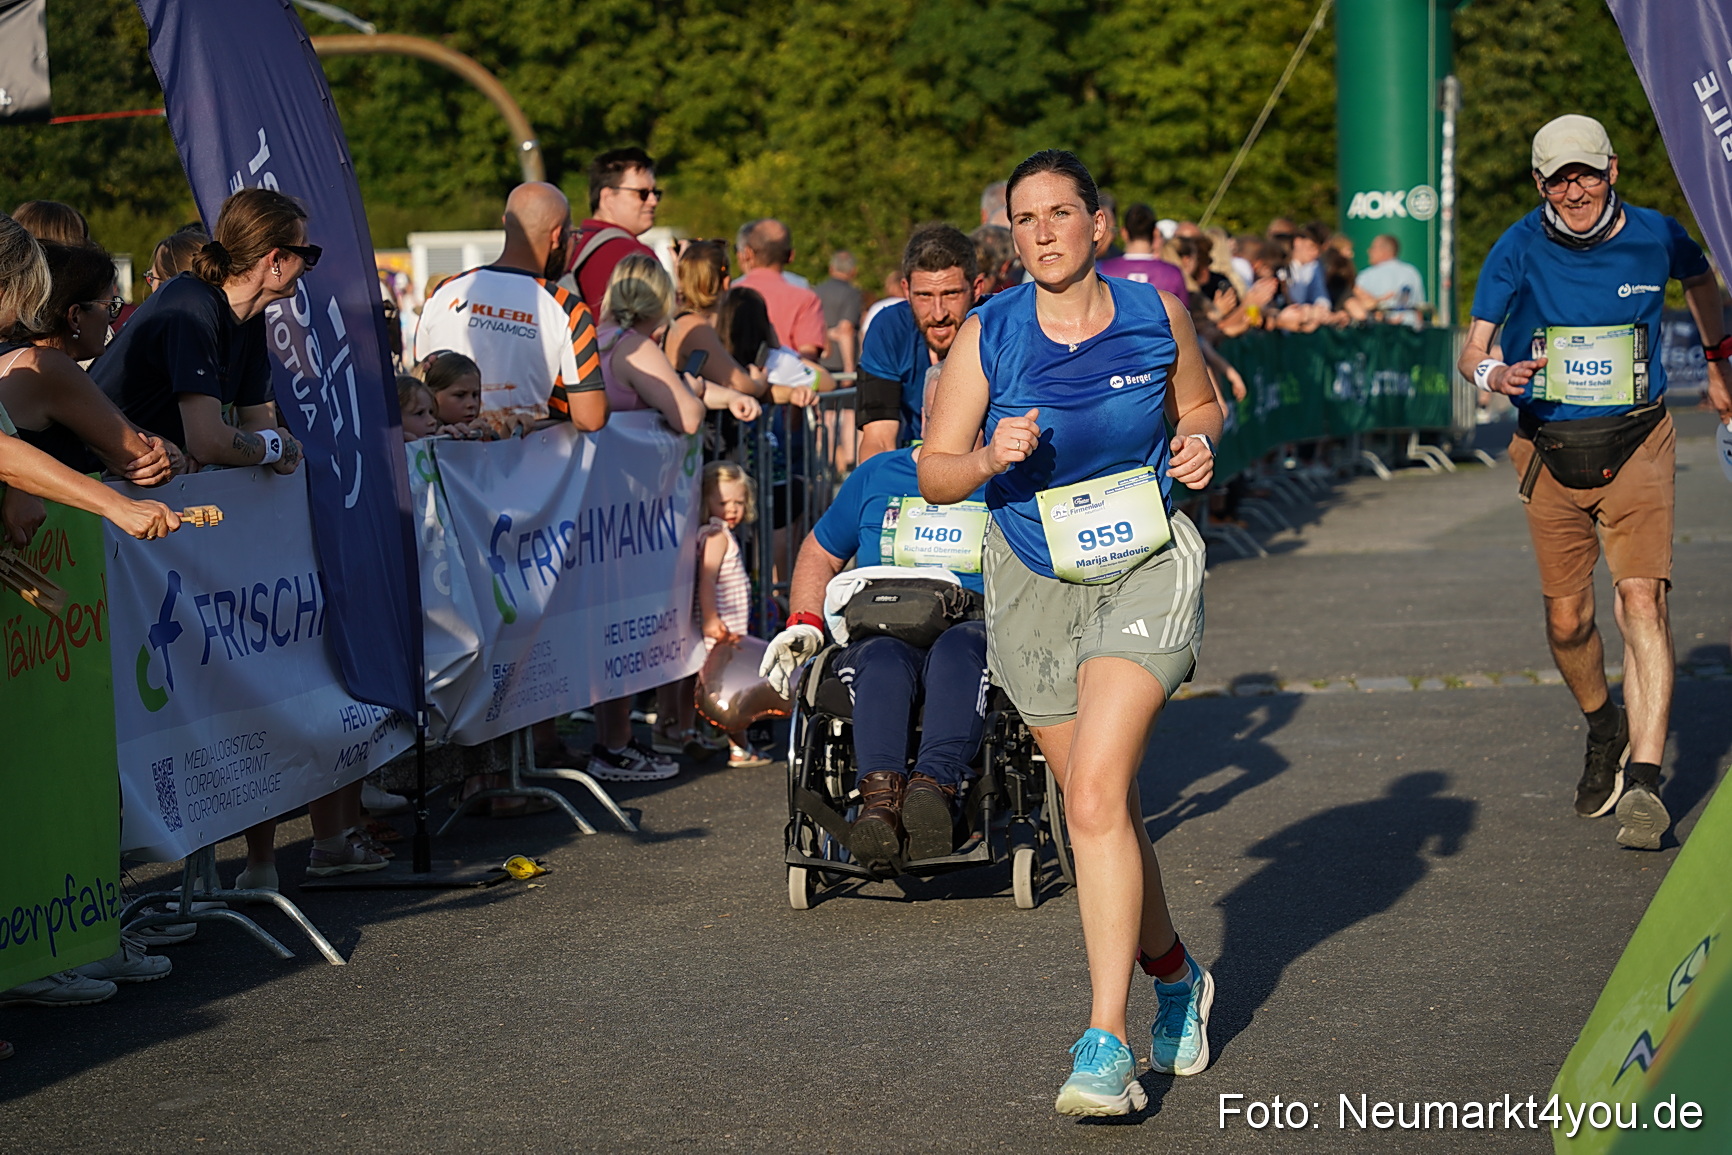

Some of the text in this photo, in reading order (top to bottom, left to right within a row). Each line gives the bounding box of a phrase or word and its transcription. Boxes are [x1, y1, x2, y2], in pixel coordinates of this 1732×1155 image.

[1347, 190, 1407, 219] AOK
[467, 317, 537, 339] DYNAMICS
[471, 303, 538, 326] KLEBL
[1125, 373, 1151, 385] Berger
[1564, 360, 1612, 376] 1495
[516, 495, 678, 591] FRISCHMANN
[904, 545, 932, 553] Richard
[914, 527, 962, 543] 1480
[1078, 521, 1134, 551] 959
[1076, 555, 1108, 568] Marija
[1110, 545, 1150, 560] Radovic
[194, 571, 326, 665] FRISCH
[604, 618, 636, 646] HEUTE
[604, 651, 647, 680] MORGEN
[339, 703, 381, 733] HEUTE
[185, 752, 271, 797] CORPORATE PRINT
[187, 772, 282, 823] CORPORATE SIGNAGE
